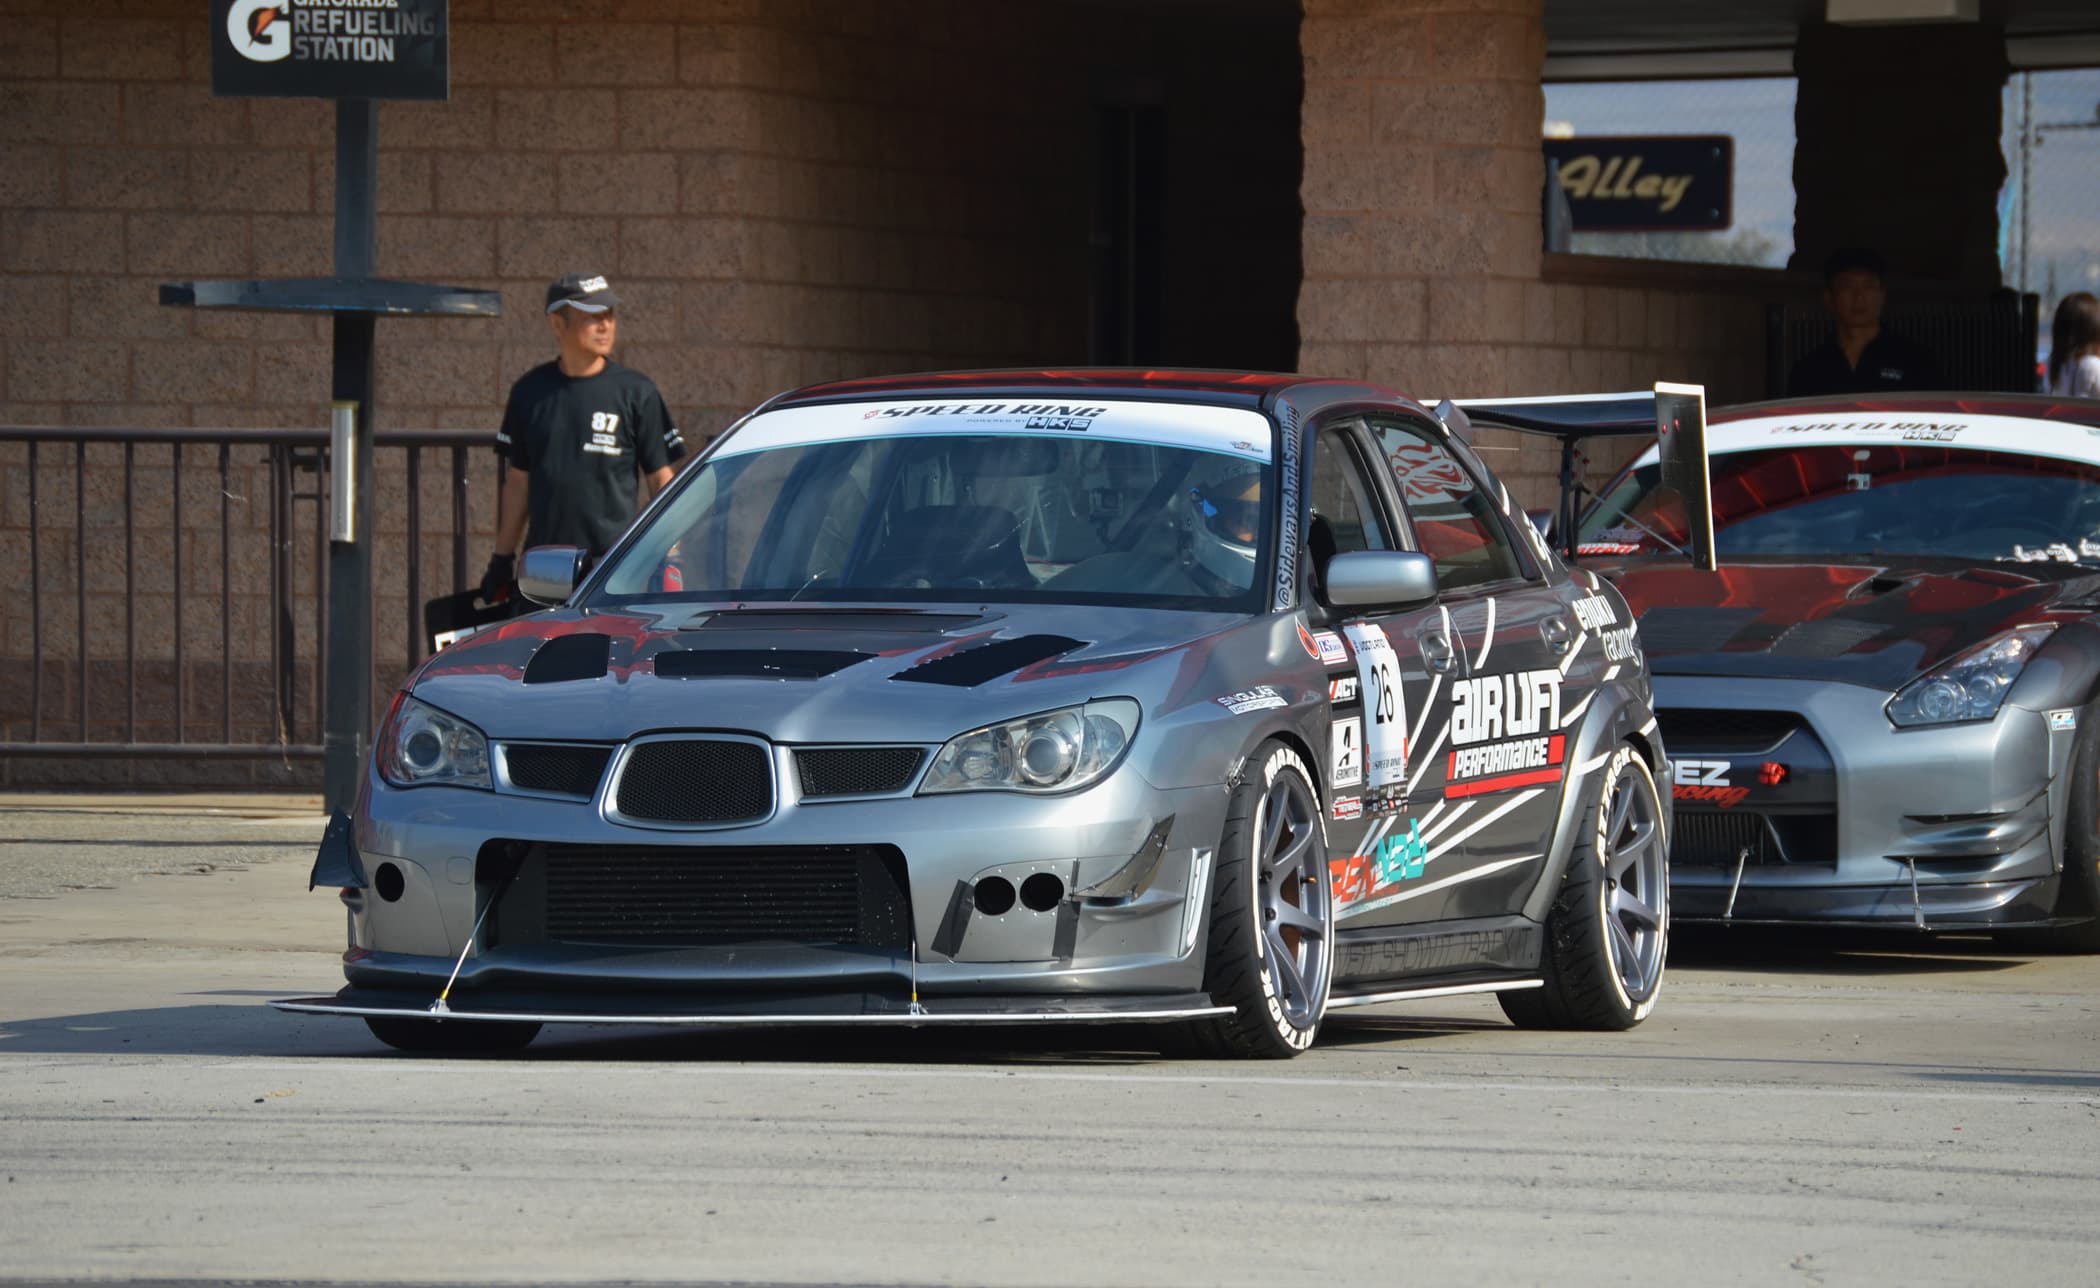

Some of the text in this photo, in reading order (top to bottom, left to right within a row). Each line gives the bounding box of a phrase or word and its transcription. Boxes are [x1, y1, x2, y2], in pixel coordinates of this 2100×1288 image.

[294, 9, 434, 35] REFUELING
[294, 35, 394, 62] STATION
[592, 411, 619, 433] 87
[881, 404, 1108, 418] SPEED RING
[1024, 416, 1093, 432] HKS
[1786, 422, 1888, 432] SPEED
[1278, 405, 1300, 606] @SidewaysAndSmiling
[1602, 627, 1640, 667] racing
[1334, 677, 1358, 700] ACT
[1371, 662, 1394, 725] 26
